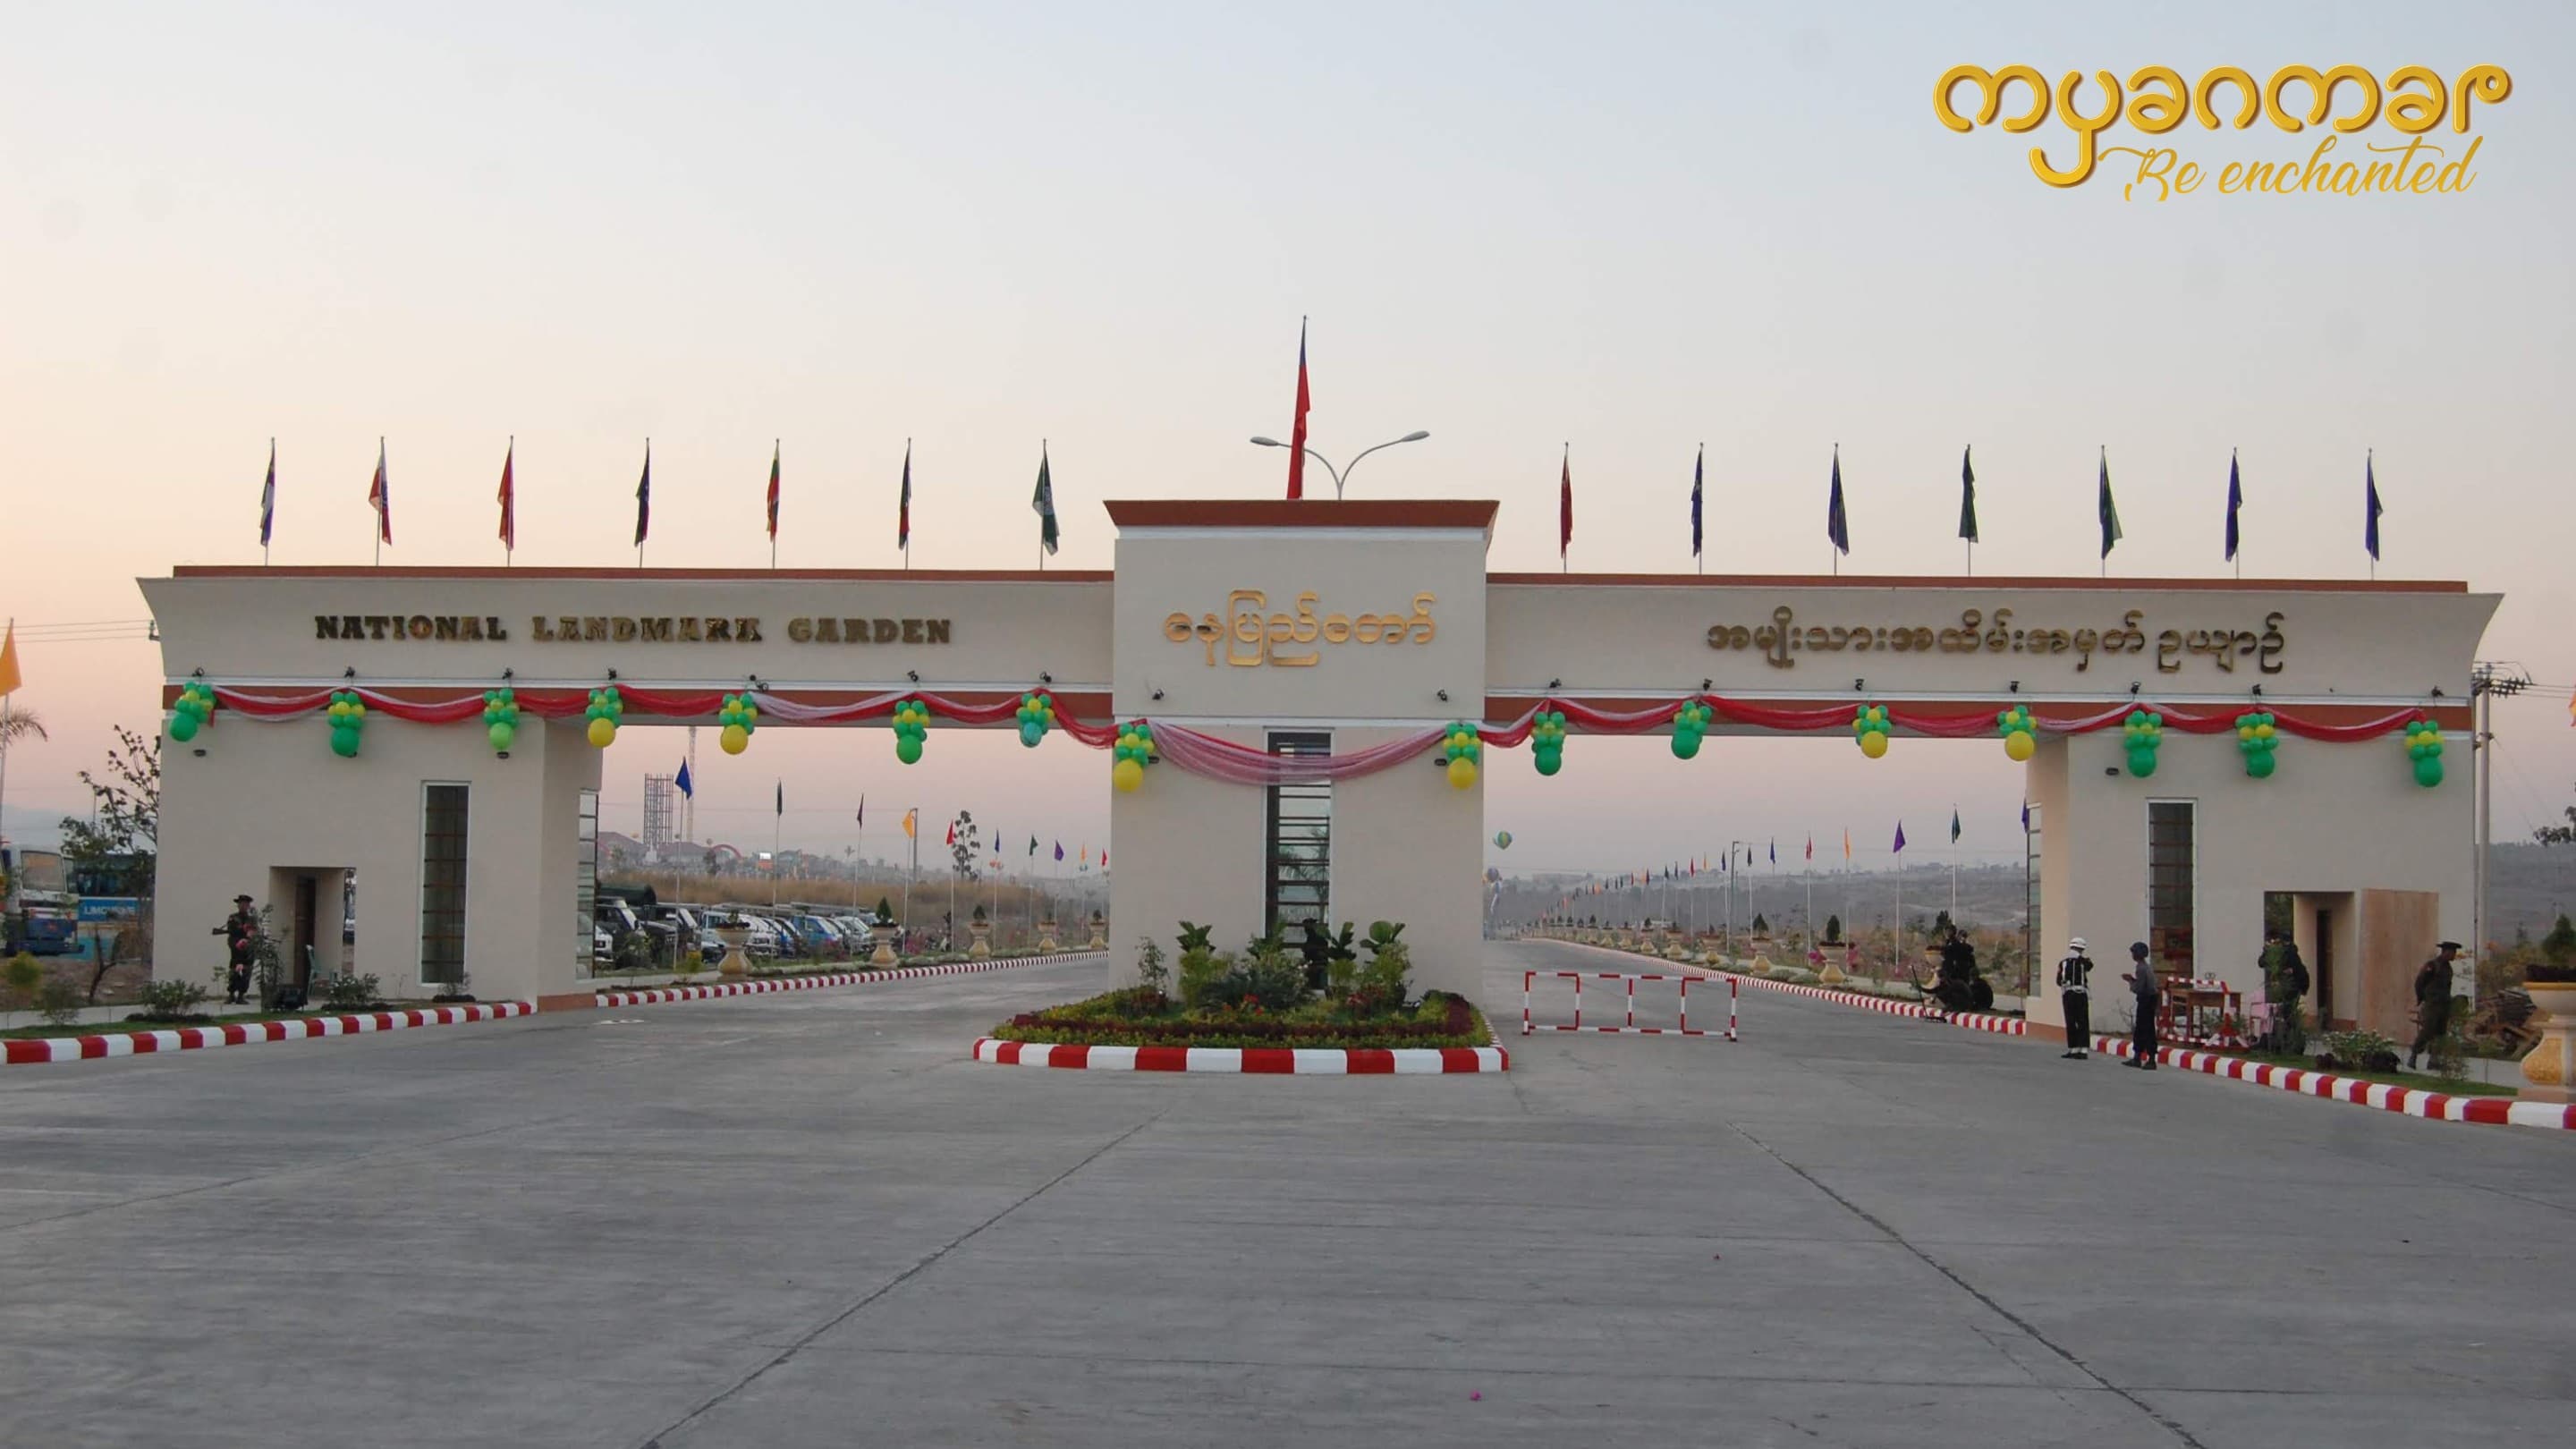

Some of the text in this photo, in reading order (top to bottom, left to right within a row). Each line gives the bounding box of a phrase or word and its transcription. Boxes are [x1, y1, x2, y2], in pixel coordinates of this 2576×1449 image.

[314, 614, 951, 645] NATIONAL LANDMARK GARDEN
[1164, 589, 1437, 667] နေပြည်တော်
